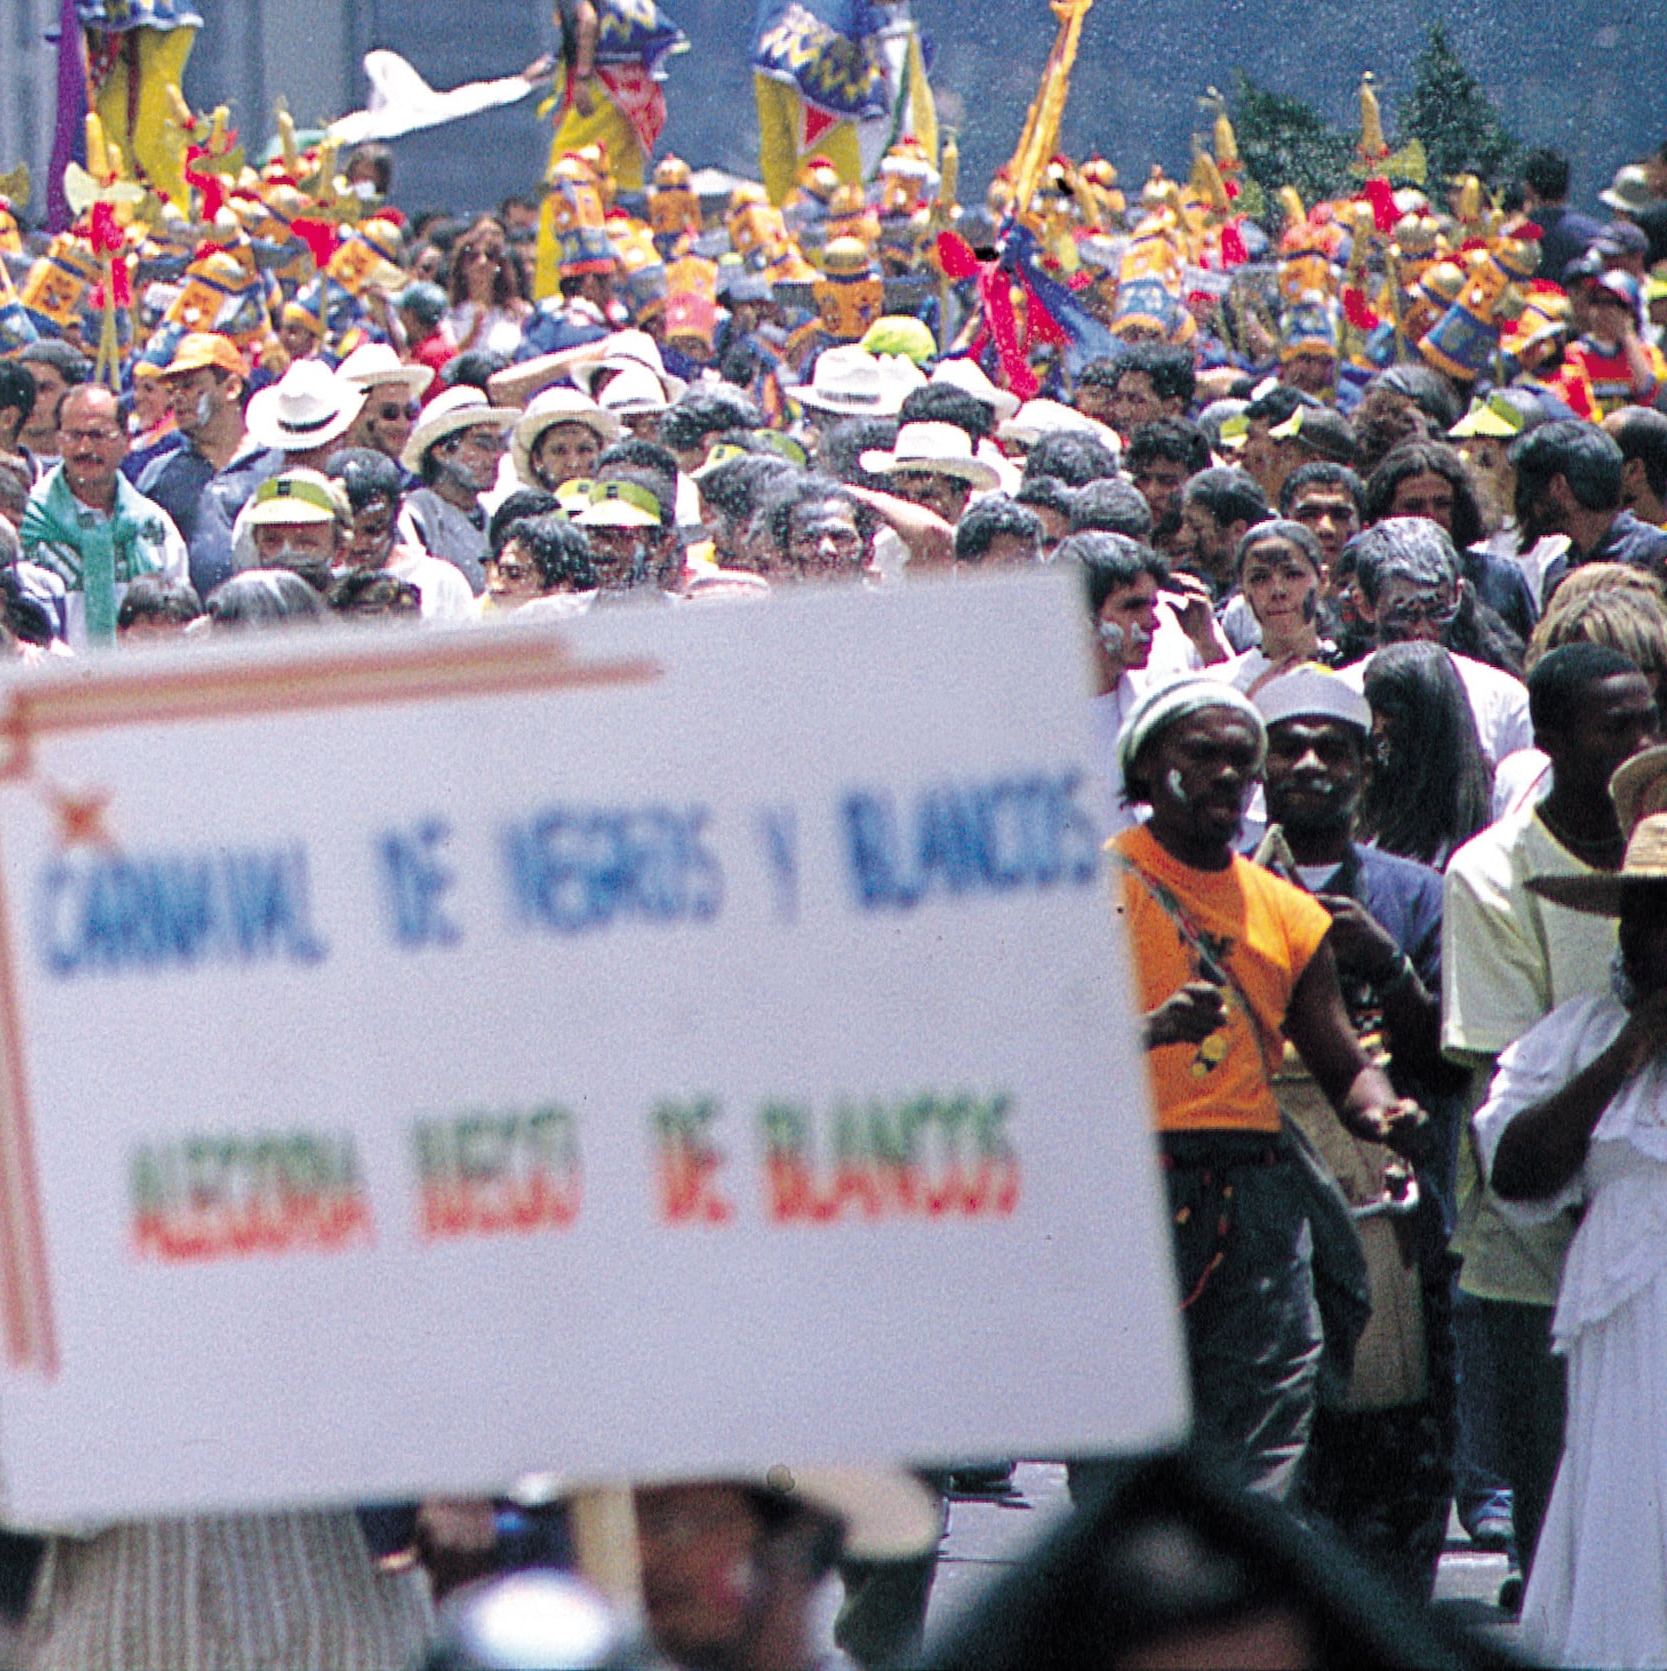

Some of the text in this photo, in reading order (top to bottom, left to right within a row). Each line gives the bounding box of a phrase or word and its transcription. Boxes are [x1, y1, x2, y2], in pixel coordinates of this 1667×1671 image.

[33, 840, 331, 980] CARNAVAL
[380, 814, 464, 950] DE
[500, 799, 723, 937] NEGROS
[837, 768, 1101, 913] BLANCOS
[648, 1090, 734, 1225] DE
[760, 1085, 1021, 1225] BLANCOS
